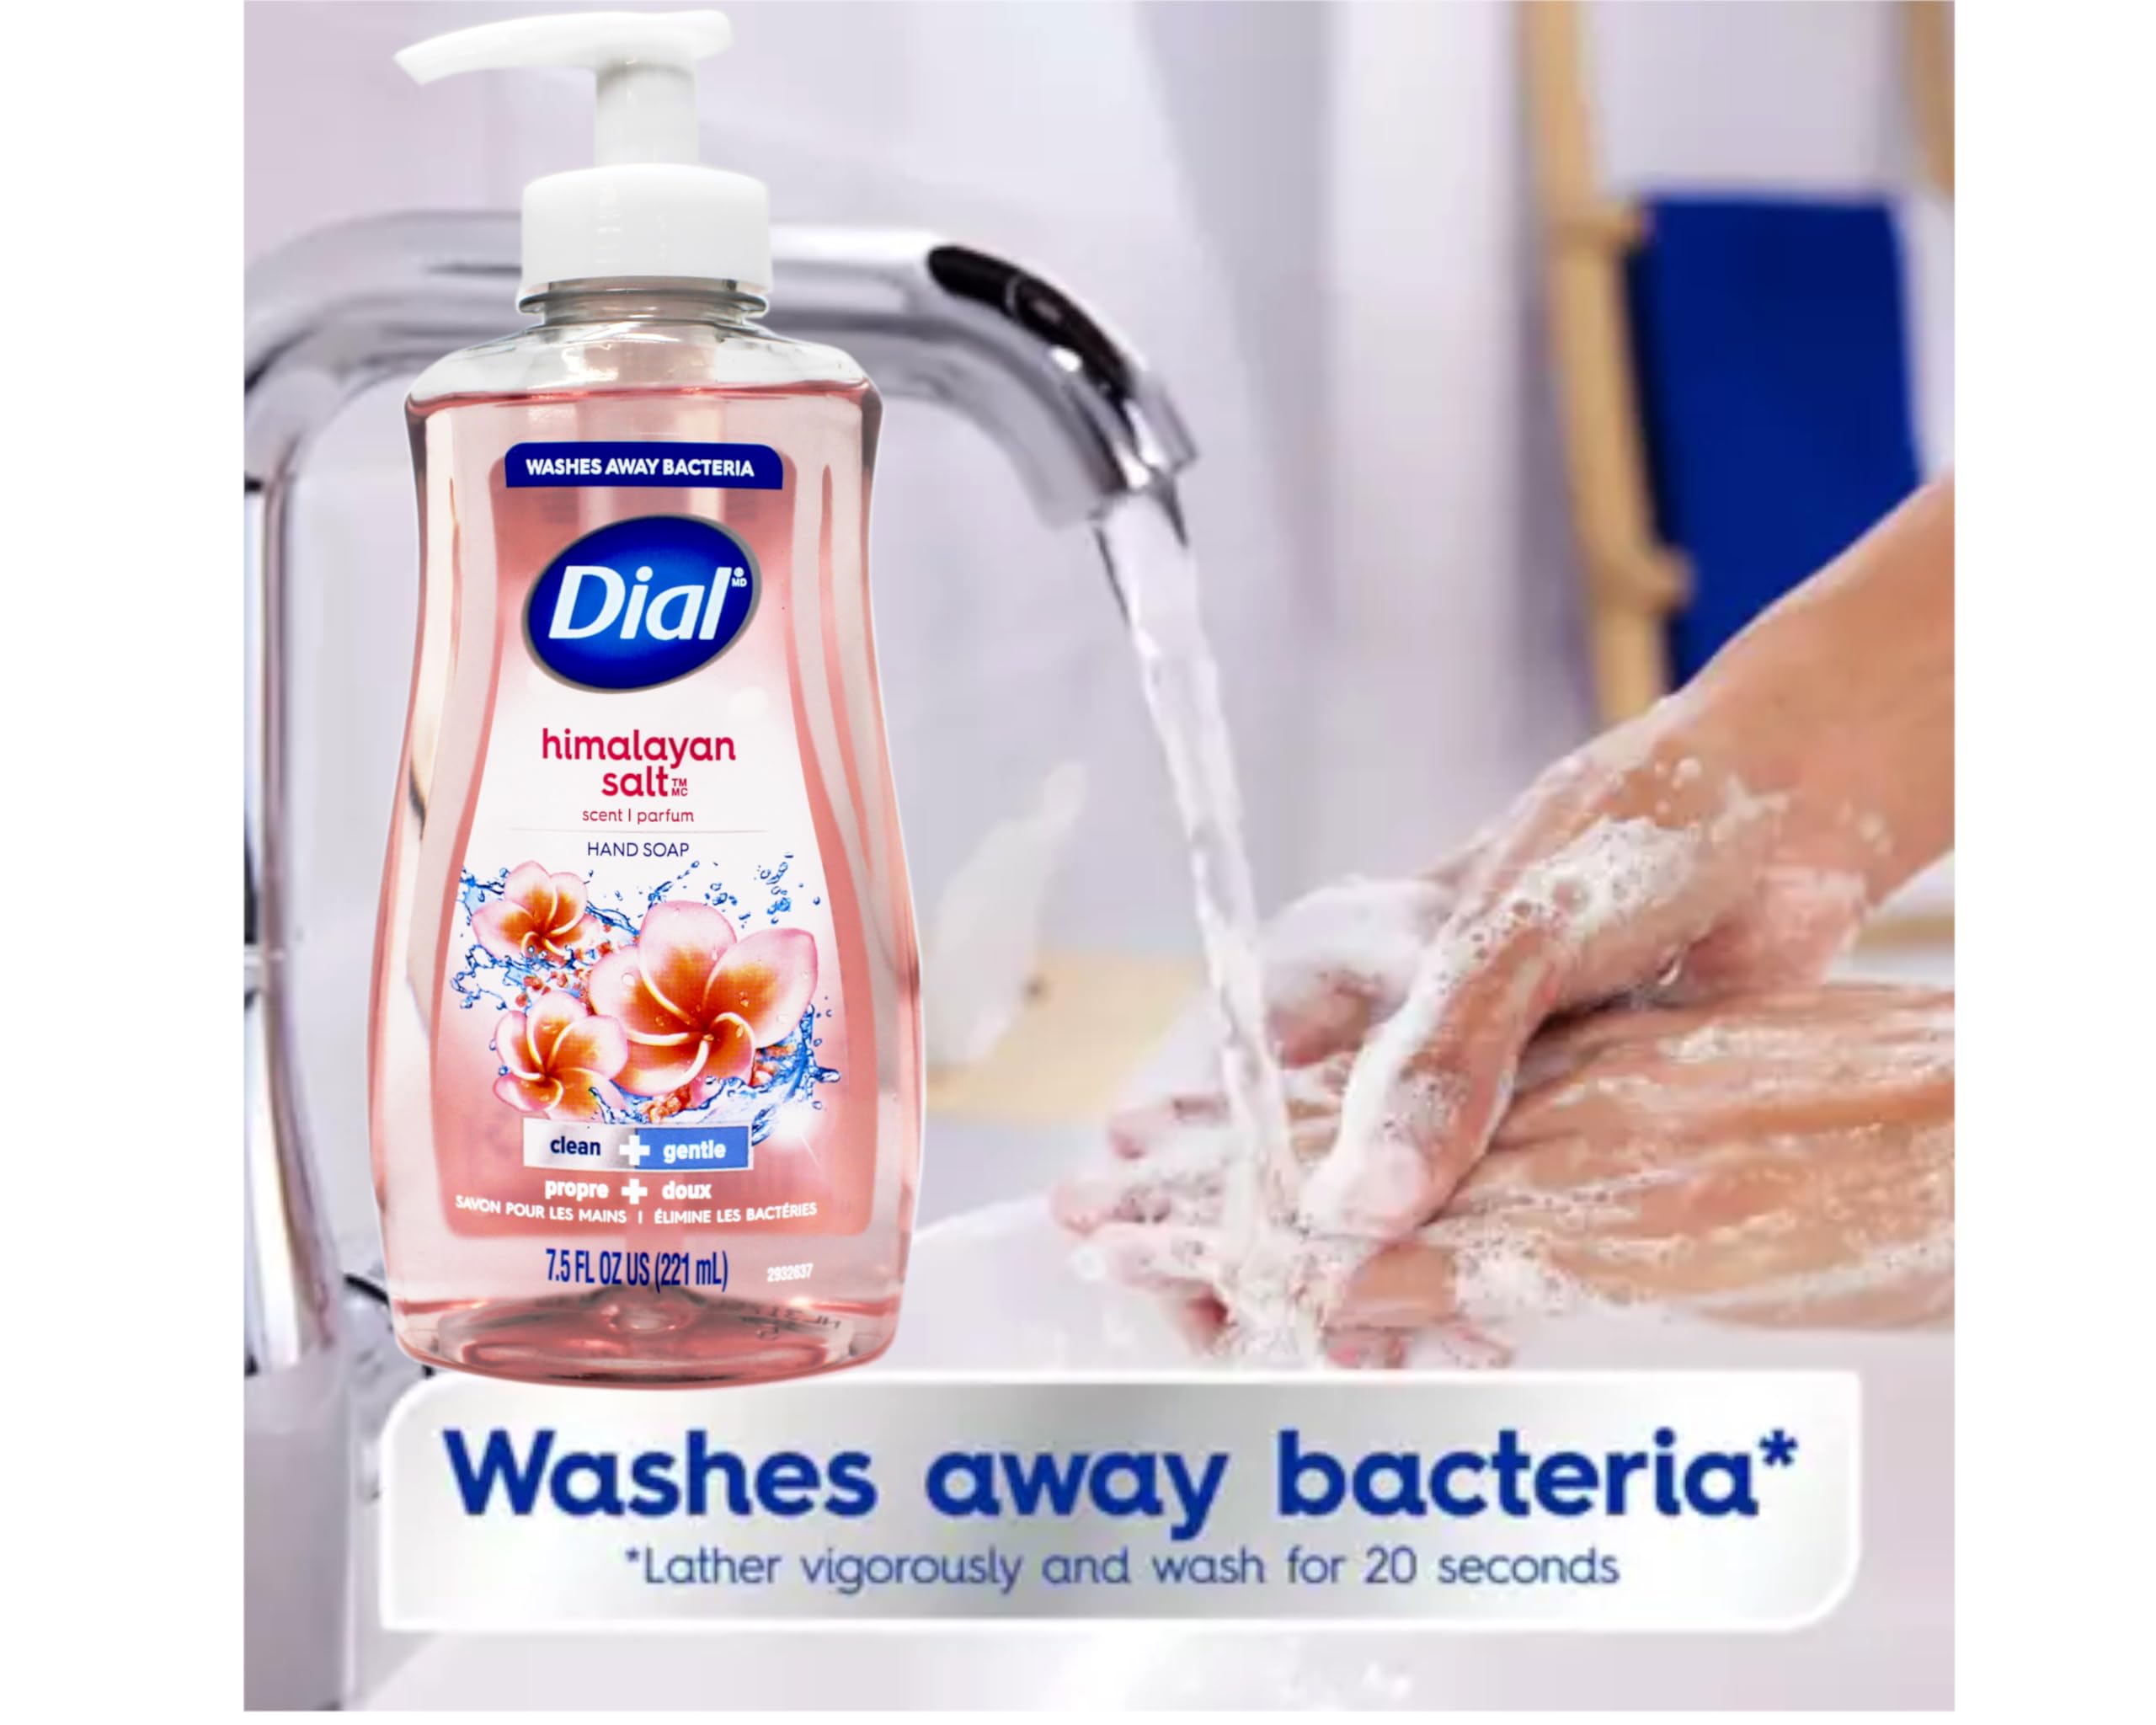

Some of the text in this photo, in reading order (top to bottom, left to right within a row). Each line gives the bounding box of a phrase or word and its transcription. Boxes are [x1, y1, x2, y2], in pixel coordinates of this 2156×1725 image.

[526, 458, 755, 477] WASHES AWAY BACTERIA
[731, 577, 748, 587] MD
[548, 565, 732, 641] Dial
[542, 727, 737, 770] himalayan
[601, 766, 669, 798] salt
[671, 777, 687, 787] TM
[671, 788, 689, 797] MC
[582, 809, 695, 825] scent parfum
[587, 841, 691, 857] HAND SOAP
[550, 1135, 727, 1164] clean gentle
[544, 1180, 712, 1202] propre doux
[455, 1194, 818, 1225] SAVON POUR LES MAINS ÉLIMINE LES BACTÉRIES
[545, 1247, 728, 1293] 7.5 FL OZ US (221 mL)
